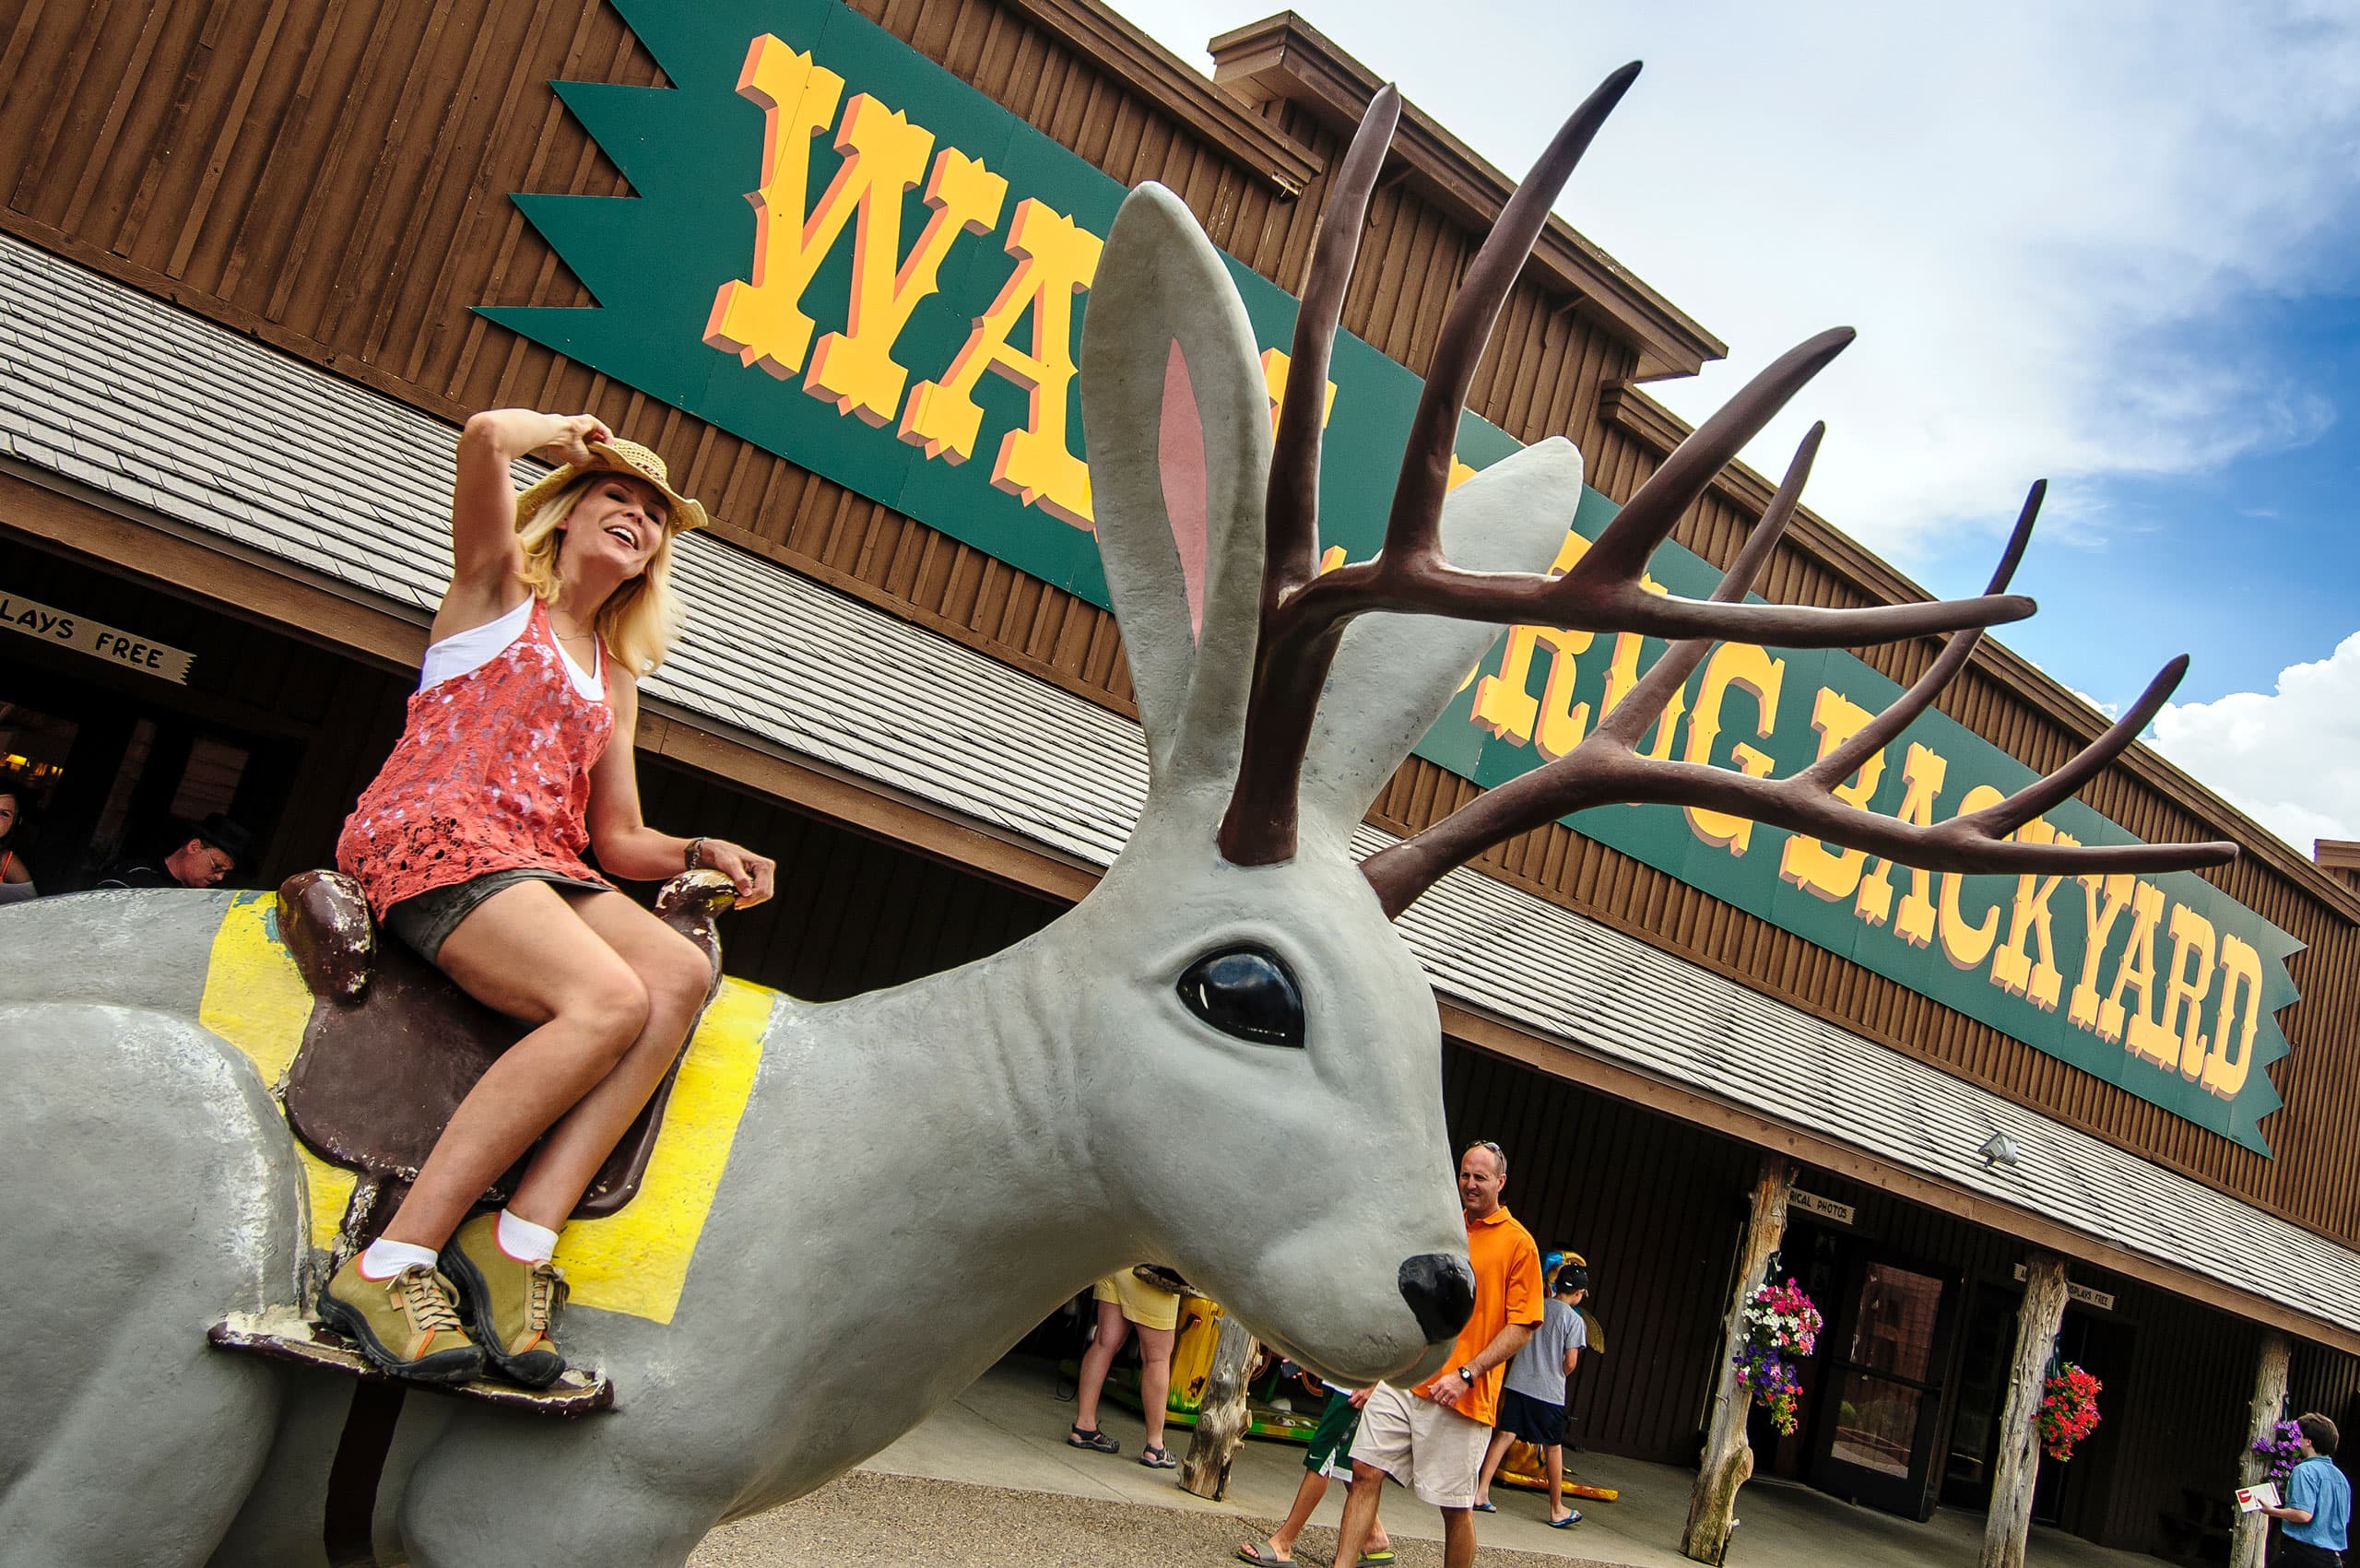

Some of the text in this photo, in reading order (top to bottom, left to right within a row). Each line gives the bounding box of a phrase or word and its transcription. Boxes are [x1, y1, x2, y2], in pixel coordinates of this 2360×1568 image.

[0, 599, 164, 668] LAYS FREE
[1448, 454, 1786, 858] RUG
[1778, 686, 2263, 1103] BACKYARD
[1817, 1200, 1847, 1219] PHOTOS
[2094, 1293, 2109, 1306] FREE
